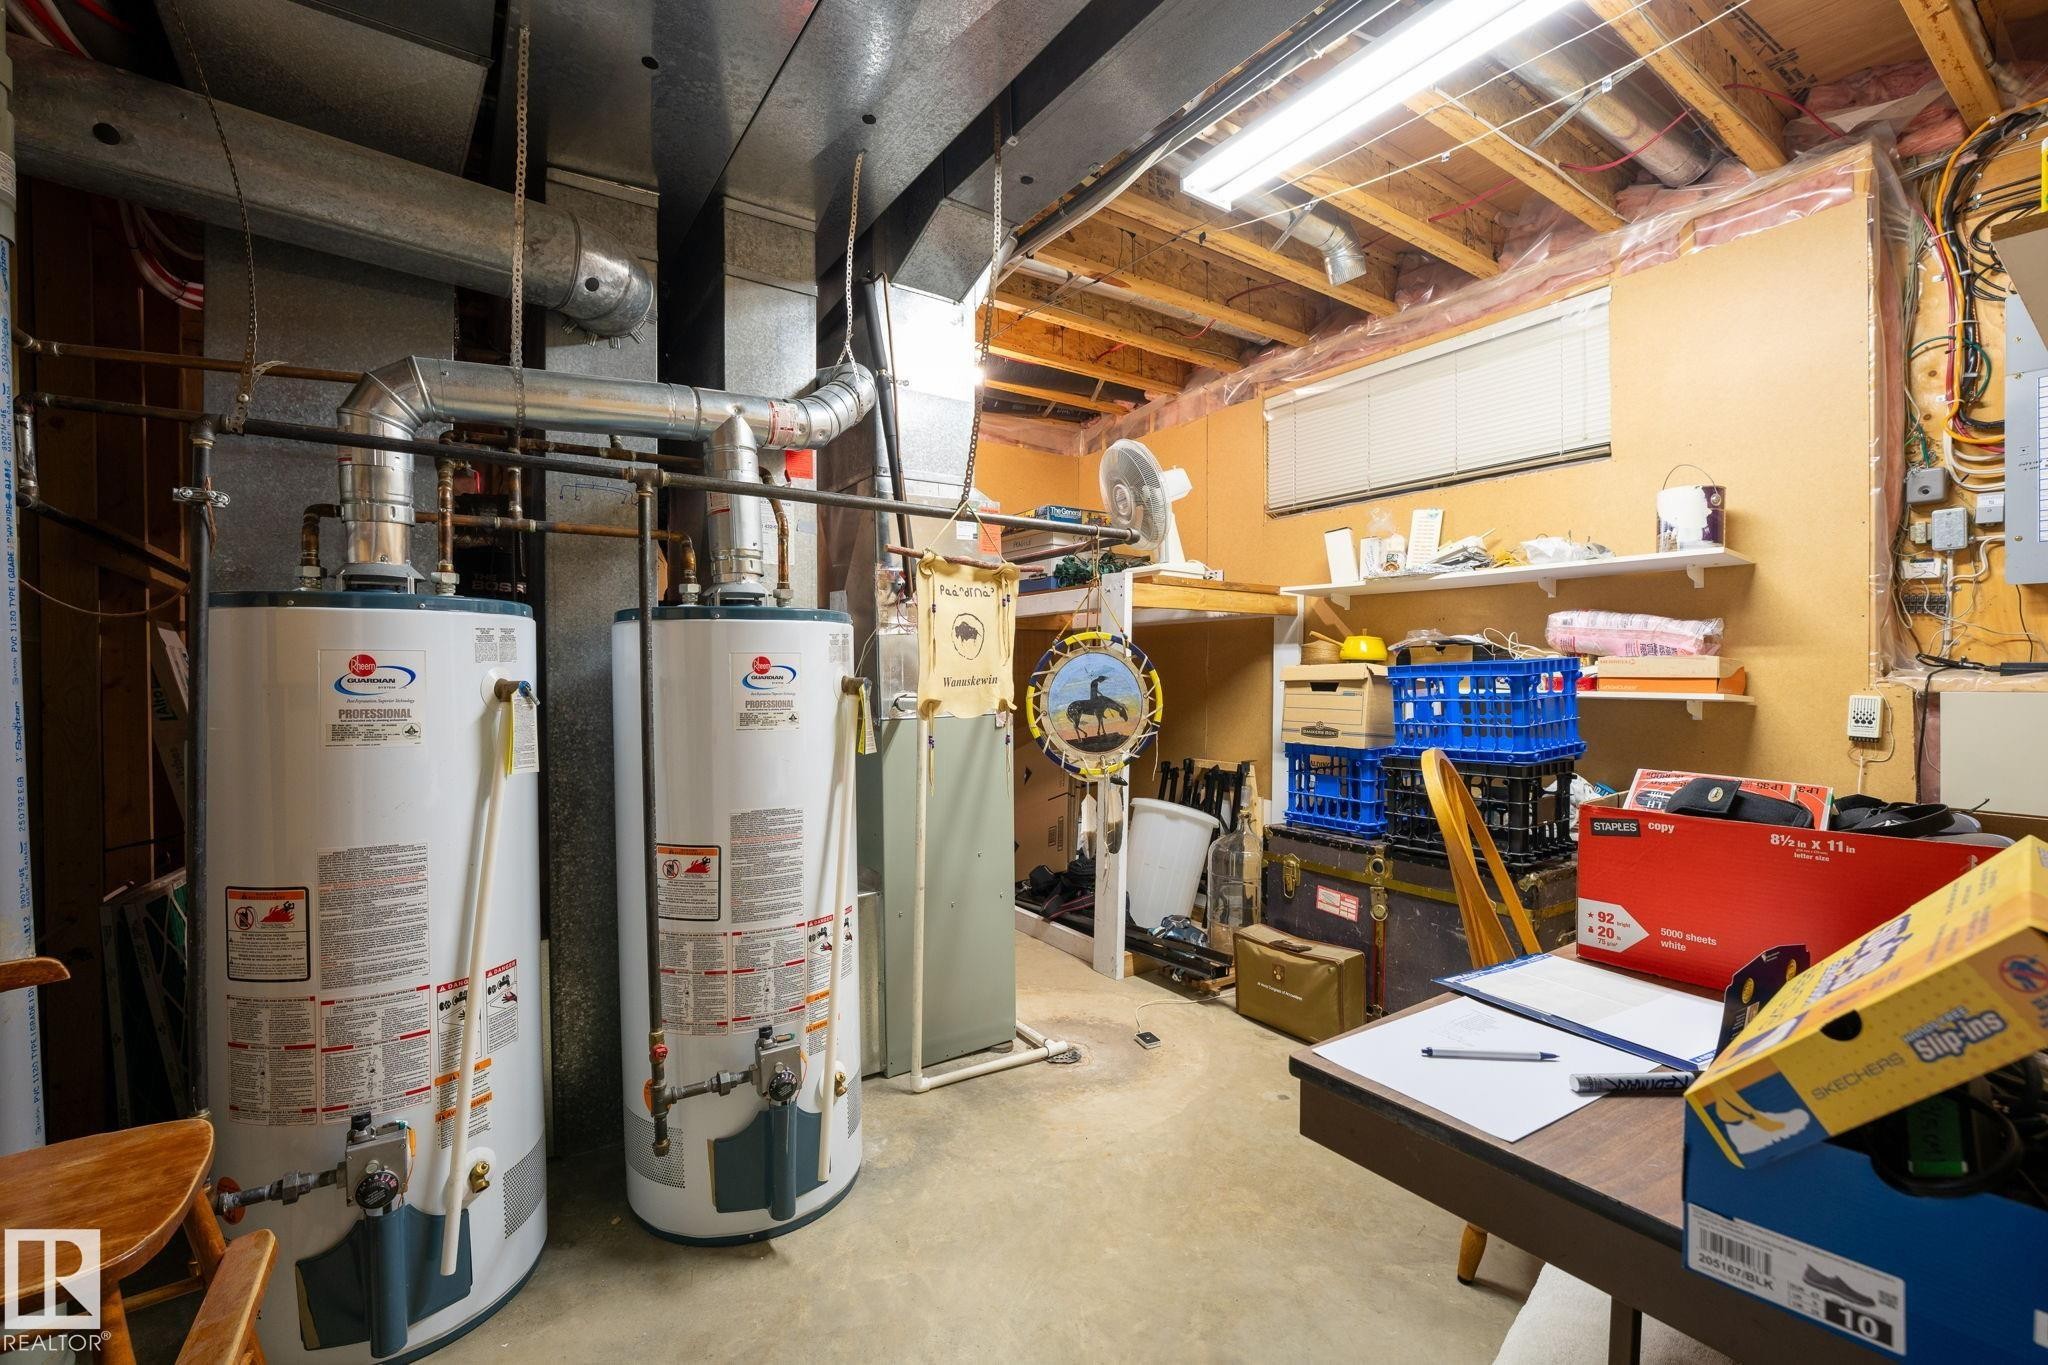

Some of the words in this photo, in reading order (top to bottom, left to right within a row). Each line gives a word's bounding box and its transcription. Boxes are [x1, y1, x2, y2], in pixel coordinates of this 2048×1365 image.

[1050, 506, 1062, 514] The
[7, 551, 15, 579] GRADE
[8, 587, 16, 607] TYPE
[351, 656, 376, 673] Rheem
[753, 657, 771, 672] Rheem
[943, 674, 998, 688] Wanuskewin
[745, 700, 794, 709] PROFESSIONAL
[338, 708, 412, 719] PROFESSIONAL
[17, 796, 26, 832] 250792
[1593, 822, 1637, 832] STAPLES
[1648, 822, 1675, 834] copy
[1797, 840, 1807, 848] in
[1827, 839, 1844, 852] 11
[1846, 845, 1856, 854] in
[1794, 852, 1813, 860] letter
[1597, 911, 1614, 925] 92
[1616, 920, 1631, 929] bright
[1597, 925, 1614, 939] 20
[1660, 927, 1683, 939] 5000
[1685, 932, 1717, 946] sheets
[1597, 937, 1606, 945] 75
[1660, 939, 1687, 952] white
[493, 960, 516, 975] DANGER
[447, 978, 469, 990] DANG
[1811, 1052, 1905, 1101] SKECHERS
[1698, 1252, 1775, 1292] 205167/BLK
[1837, 1307, 1880, 1340] 10
